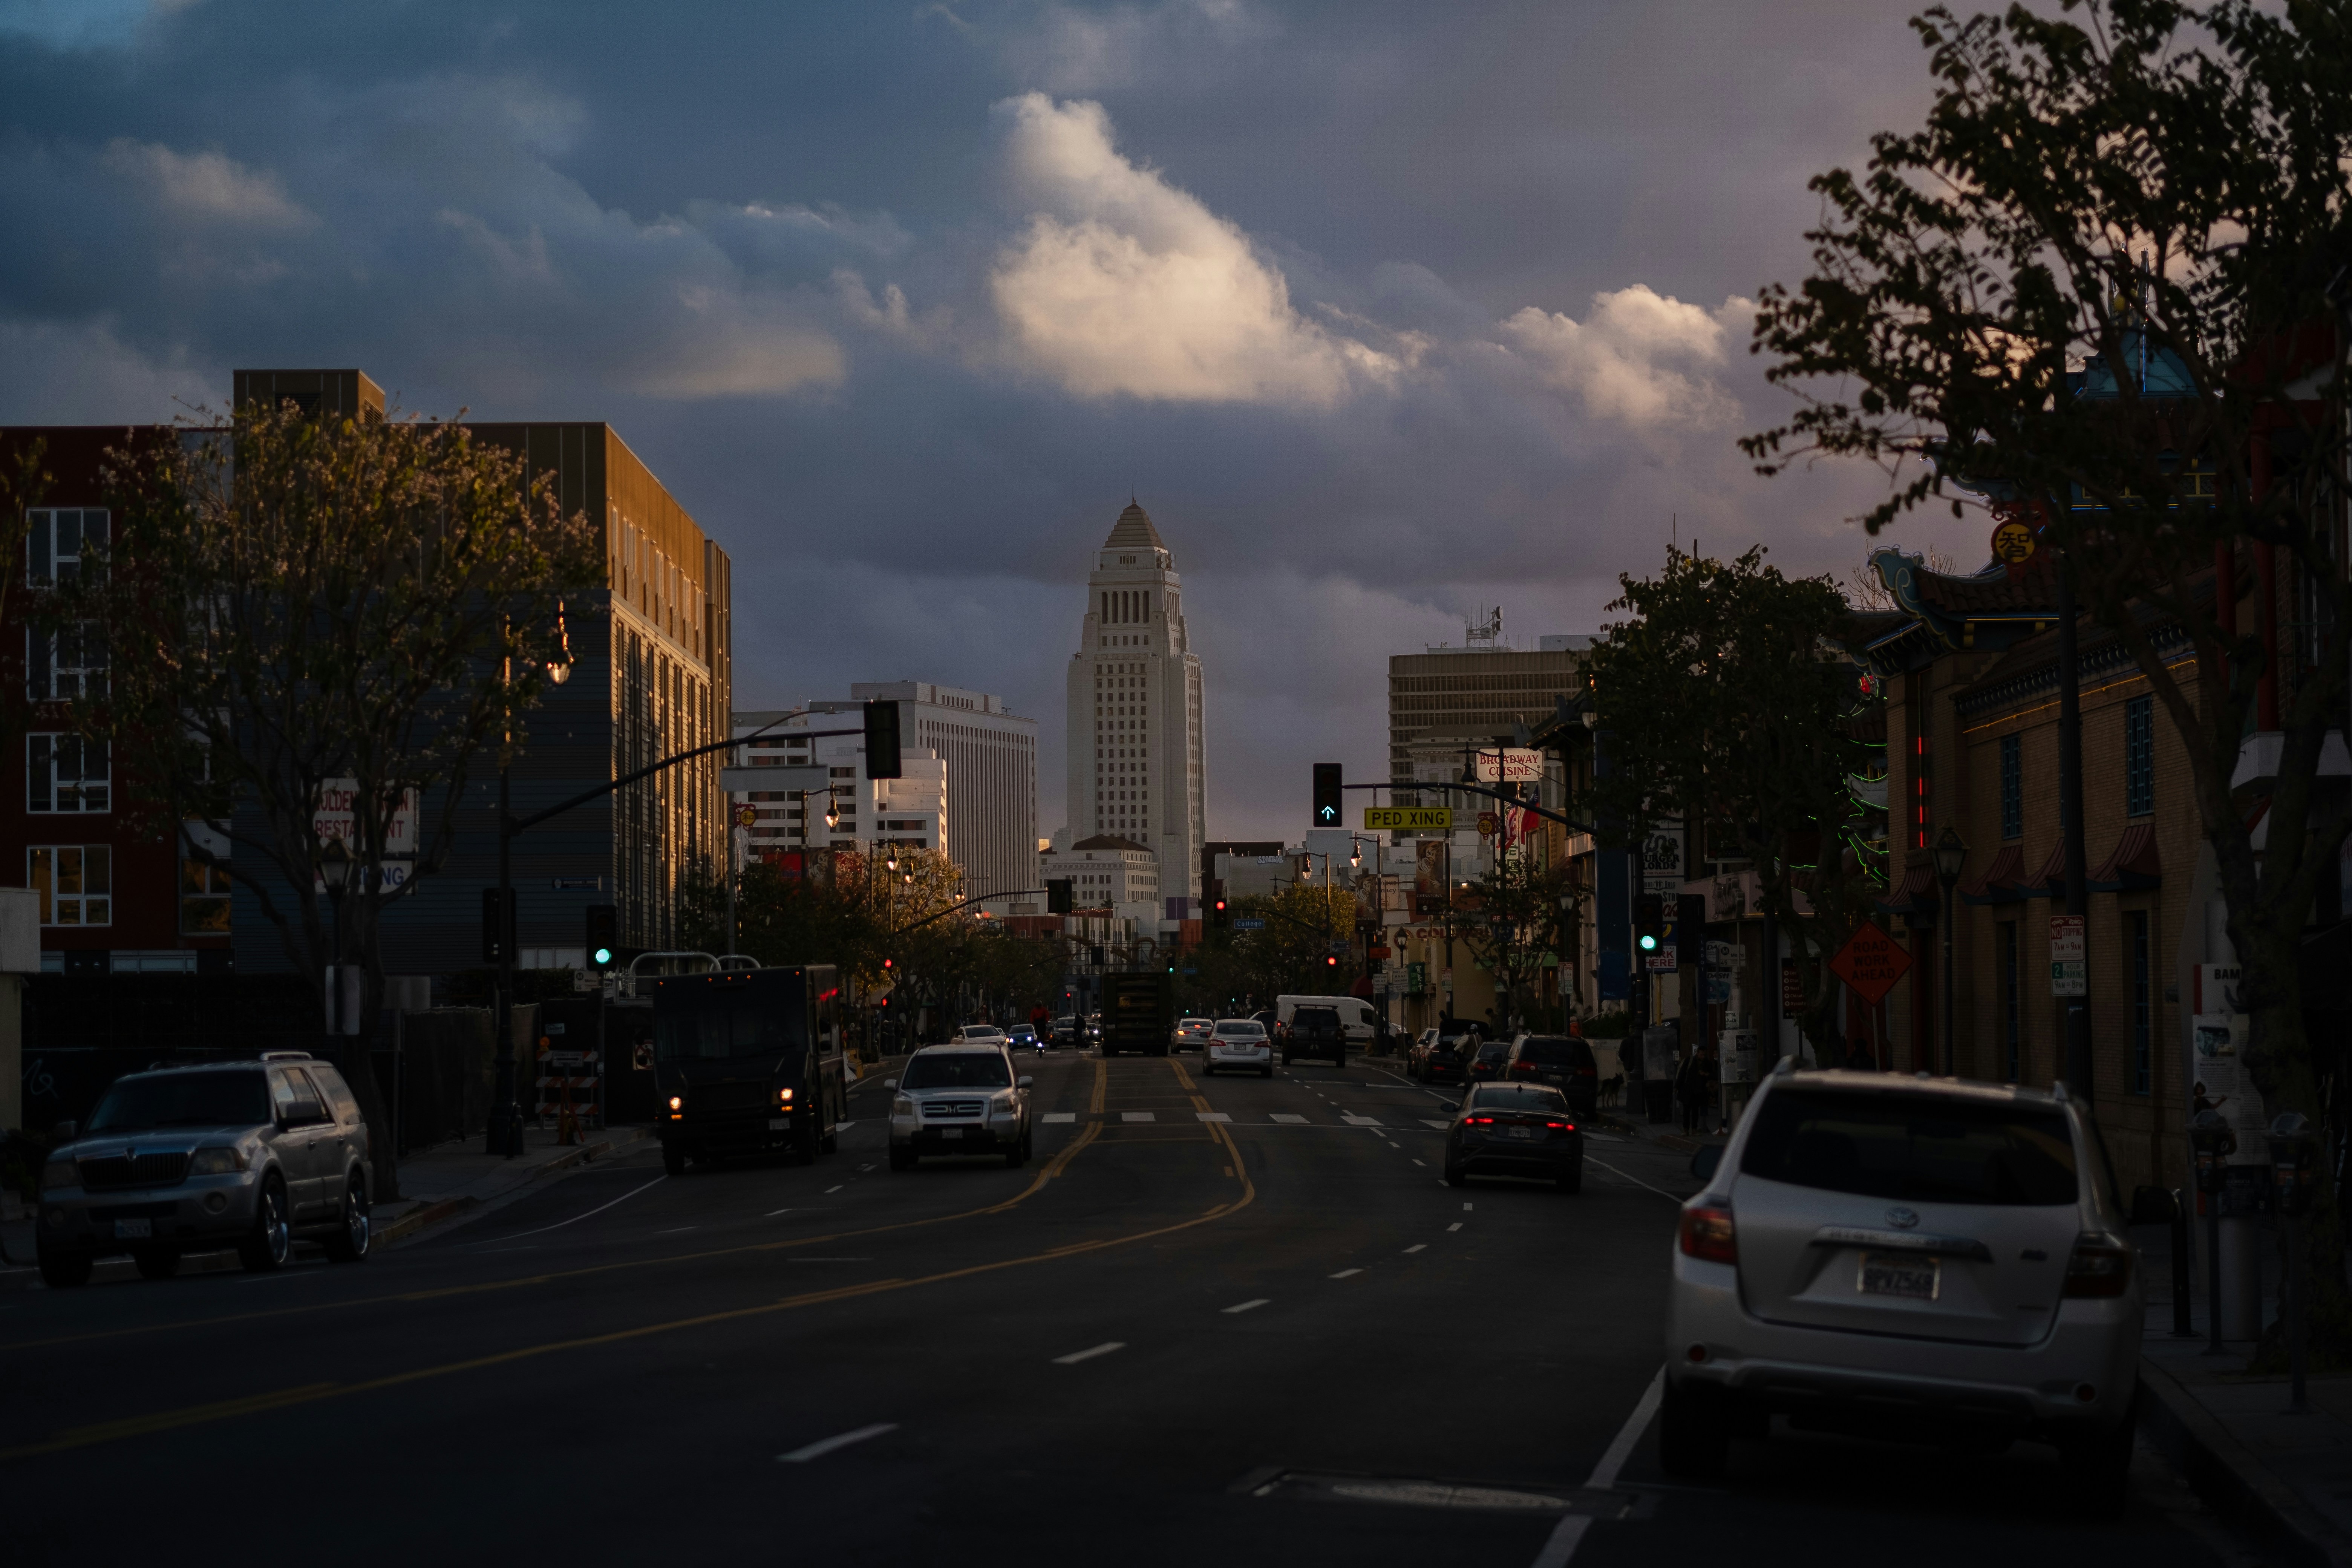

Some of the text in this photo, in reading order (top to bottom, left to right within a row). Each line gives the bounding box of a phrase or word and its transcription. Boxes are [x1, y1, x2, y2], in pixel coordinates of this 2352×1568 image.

[1372, 812, 1444, 825] PED XING
[2052, 927, 2082, 938] NO STOPPING
[1853, 940, 1888, 953] ROAD
[2054, 942, 2064, 951] 7AM
[2070, 942, 2081, 950] 9AM
[1853, 954, 1890, 967] WORK
[1851, 968, 1895, 982] AHEAD
[2055, 965, 2084, 978] 2 PARKING
[2214, 969, 2241, 980] BAM
[2055, 980, 2065, 989] 9AM
